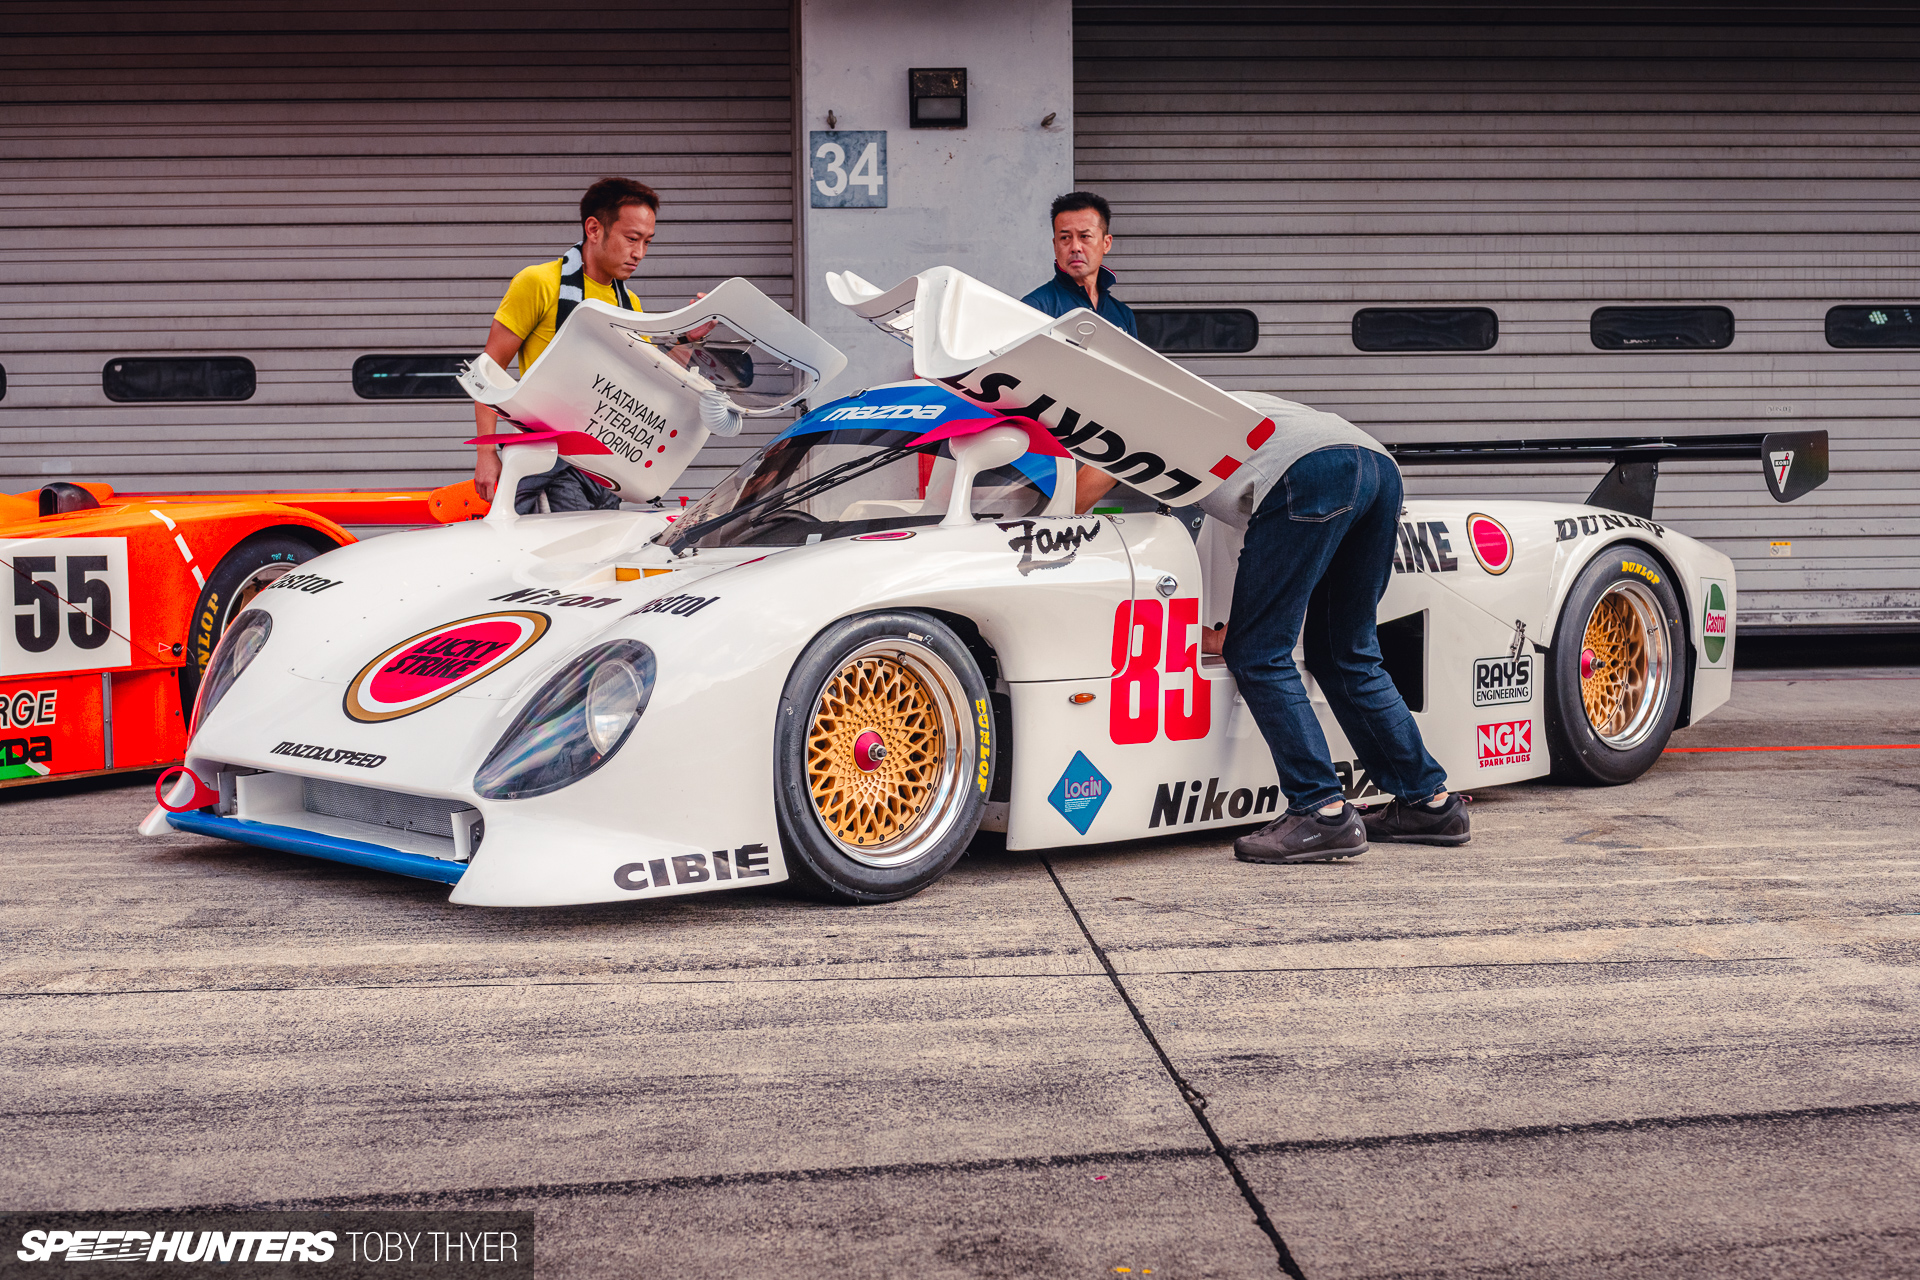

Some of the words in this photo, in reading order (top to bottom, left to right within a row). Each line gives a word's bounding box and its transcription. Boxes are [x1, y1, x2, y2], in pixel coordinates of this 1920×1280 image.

[815, 142, 883, 196] 34
[591, 373, 667, 434] Y.KATAYAMA
[820, 404, 947, 422] mazda
[584, 418, 643, 463] T.YORINO
[594, 400, 655, 449] Y.TERADA
[1392, 521, 1458, 574] IKE
[1554, 514, 1665, 543] DUNLOP
[1621, 561, 1660, 584] DUNLOP
[12, 555, 112, 653] 55
[1706, 612, 1726, 634] Castrol
[198, 592, 219, 676] NLOP
[412, 636, 511, 660] LUCKY
[383, 654, 482, 680] STRIKE
[1109, 597, 1212, 745] 85
[1476, 660, 1530, 690] RAYS
[1476, 686, 1529, 702] ENGINEERING
[975, 698, 990, 793] DUNLOP
[1478, 720, 1531, 758] NGK
[1479, 756, 1505, 769] SPARK
[1506, 753, 1531, 765] PLUGS
[1148, 777, 1280, 829] Nikon
